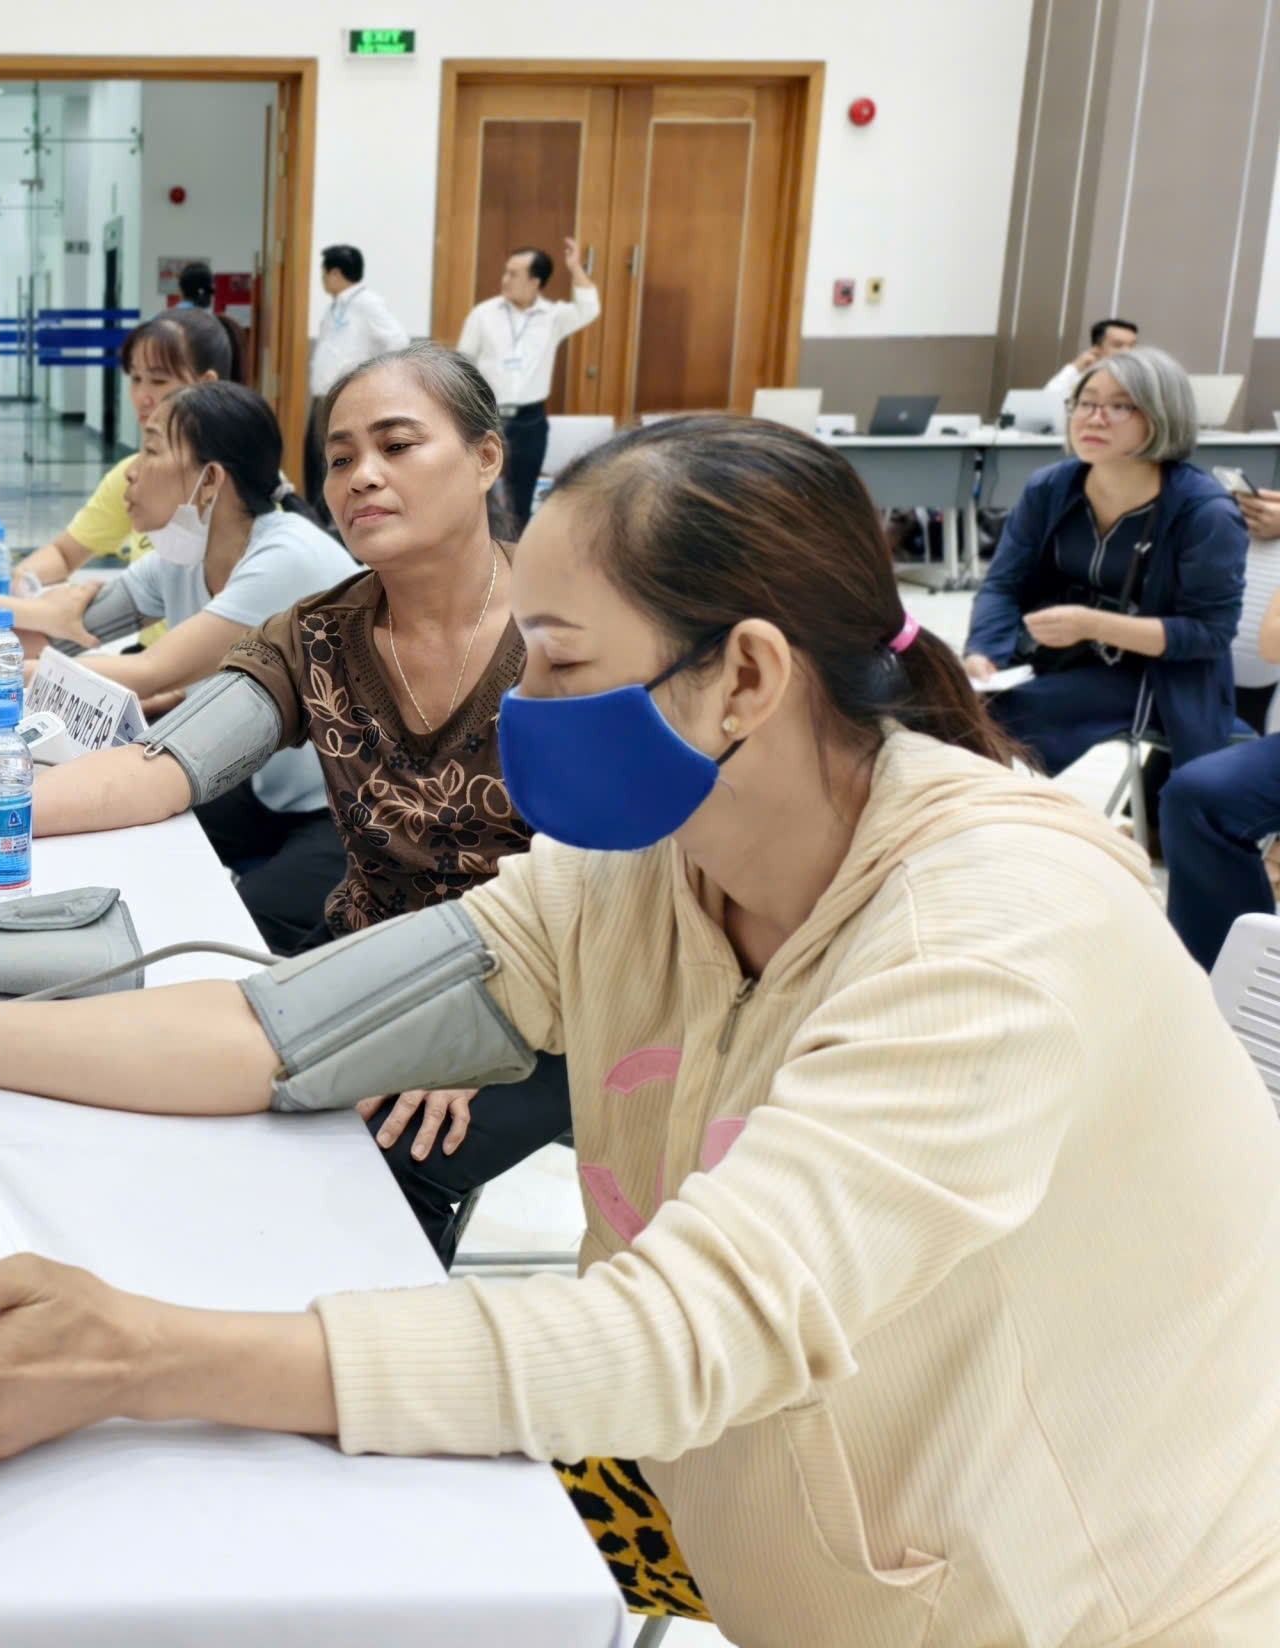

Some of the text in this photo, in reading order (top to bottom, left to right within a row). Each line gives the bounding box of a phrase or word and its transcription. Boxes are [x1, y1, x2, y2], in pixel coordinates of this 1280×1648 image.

[362, 29, 401, 43] EXIT
[68, 694, 107, 747] HUYẾT
[90, 704, 114, 751] ÁP
